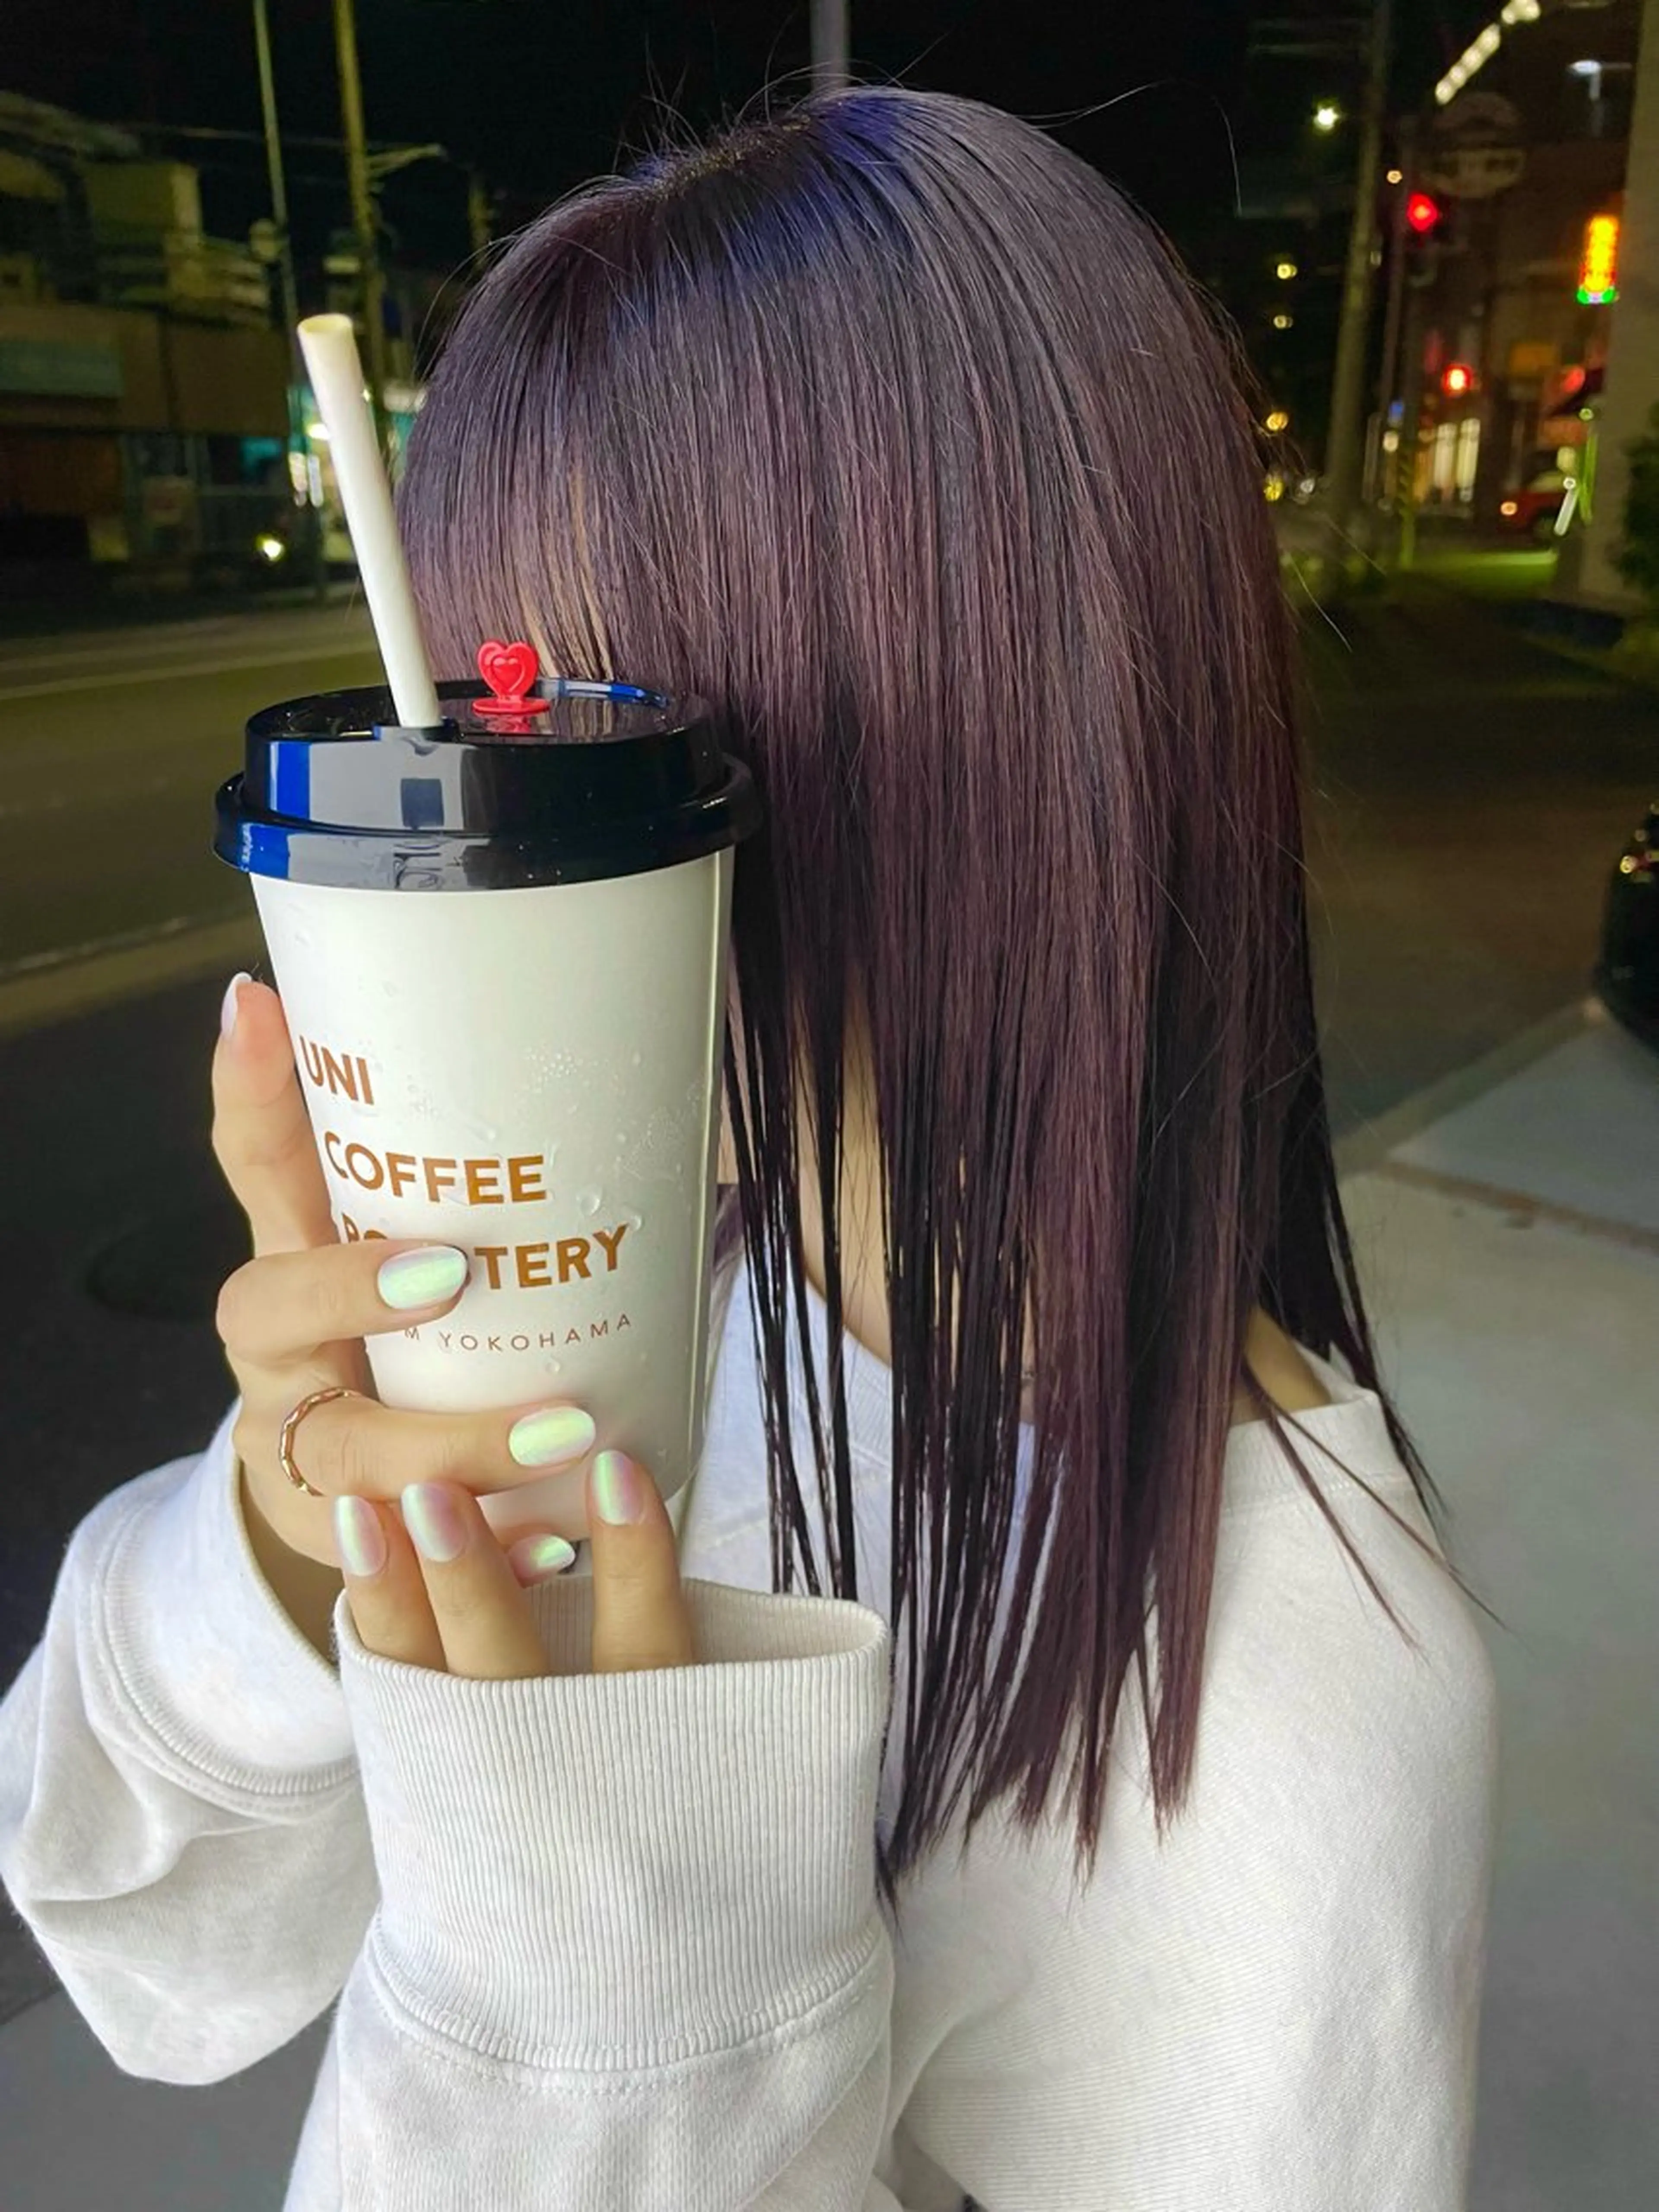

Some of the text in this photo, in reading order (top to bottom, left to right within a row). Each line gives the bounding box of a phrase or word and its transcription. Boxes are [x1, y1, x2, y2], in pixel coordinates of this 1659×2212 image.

[300, 1035, 374, 1105] UNI
[324, 1131, 547, 1205] COFFEE
[341, 1211, 629, 1290] RTERY
[439, 1313, 631, 1351] YOKOHAMA
